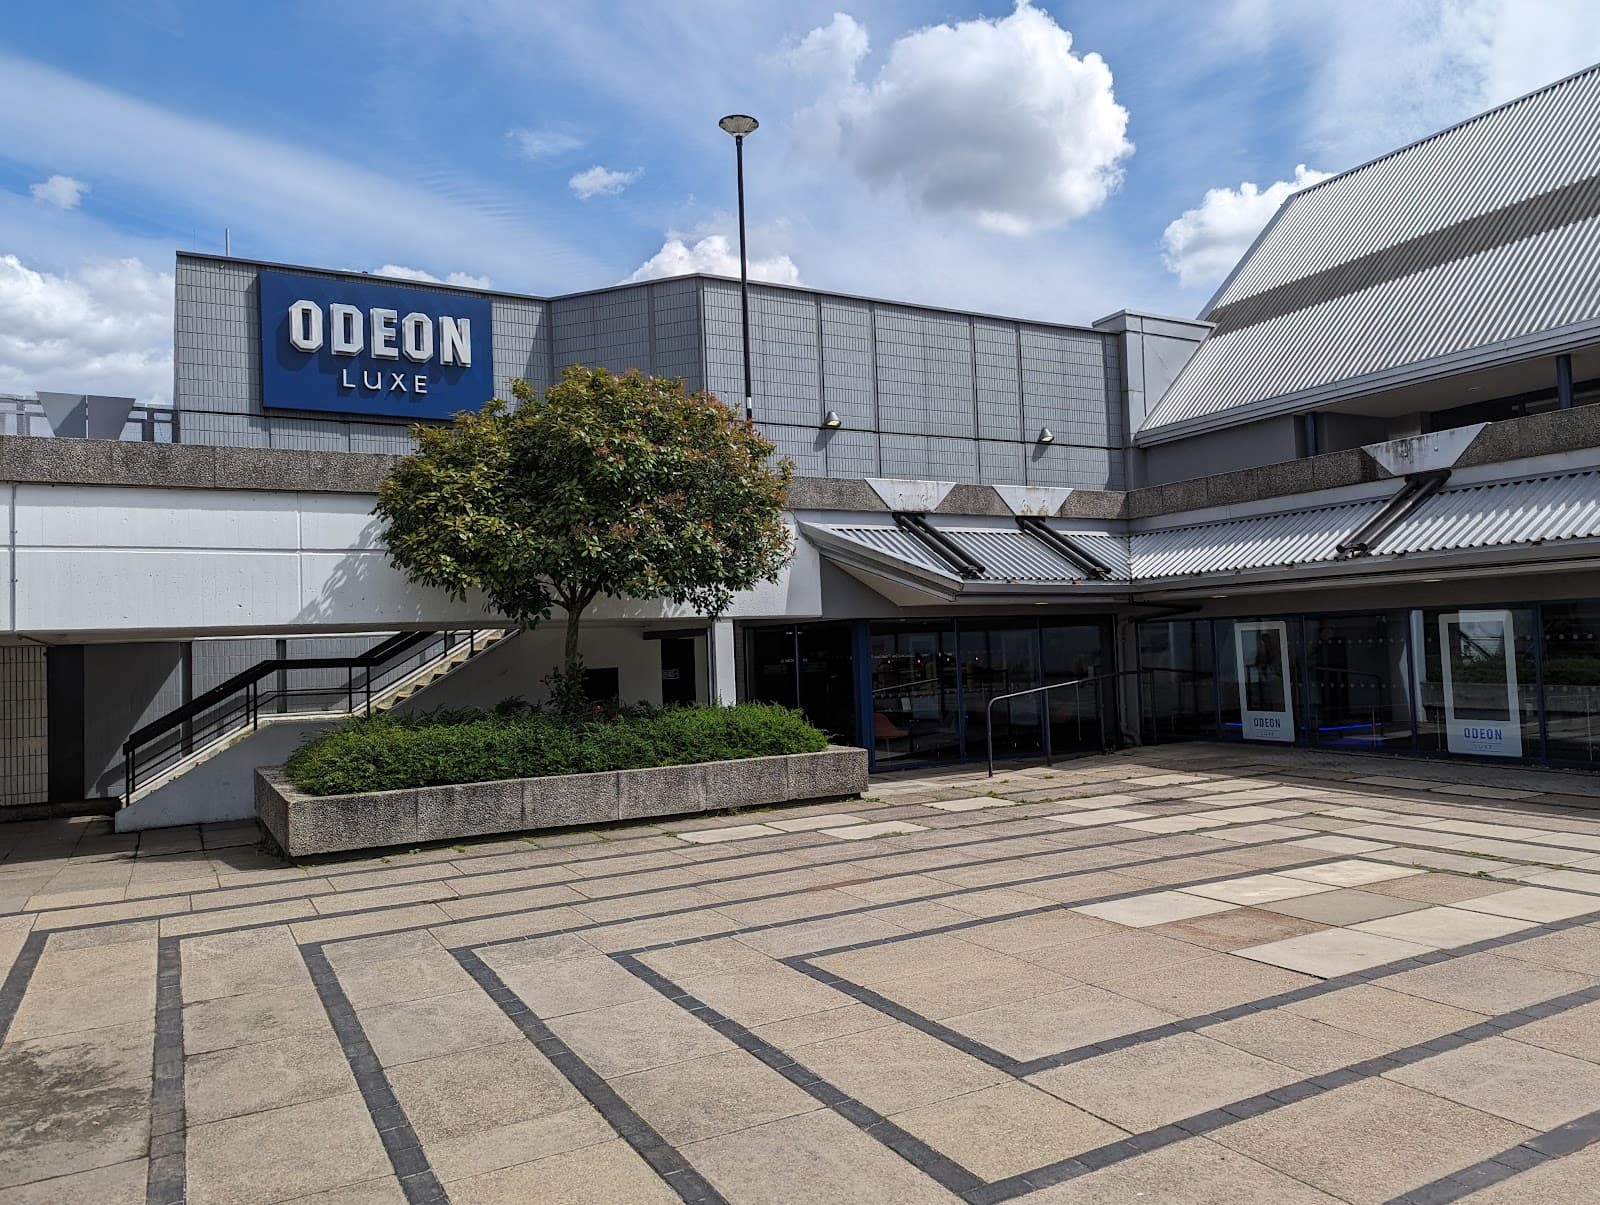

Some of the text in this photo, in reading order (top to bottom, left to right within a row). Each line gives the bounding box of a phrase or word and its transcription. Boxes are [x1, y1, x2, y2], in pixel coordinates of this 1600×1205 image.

[289, 300, 472, 368] ODEON
[342, 368, 428, 394] LUXE
[1253, 717, 1281, 728] ODEON
[1464, 727, 1503, 740] ODEON
